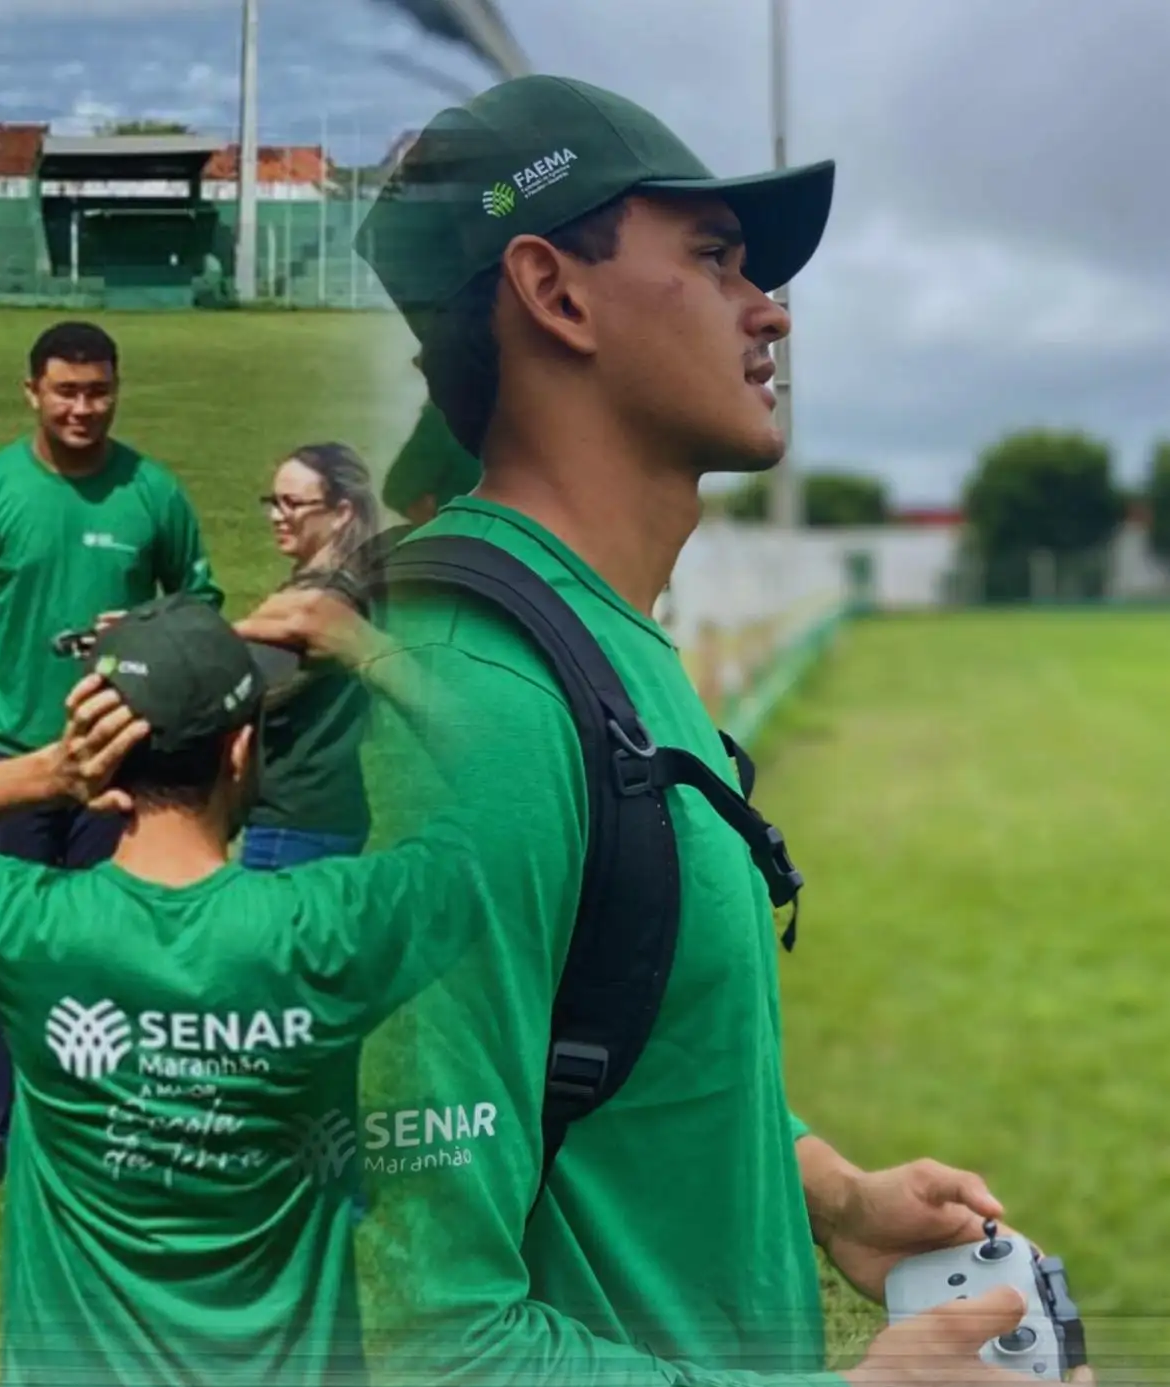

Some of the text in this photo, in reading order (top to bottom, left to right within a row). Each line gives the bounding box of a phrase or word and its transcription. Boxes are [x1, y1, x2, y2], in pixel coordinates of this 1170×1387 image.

[512, 148, 578, 188] FAEMA
[138, 1008, 314, 1051] SENAR
[138, 1054, 270, 1078] Maranhão
[364, 1102, 498, 1150] SENAR
[364, 1146, 473, 1175] Maranhão
